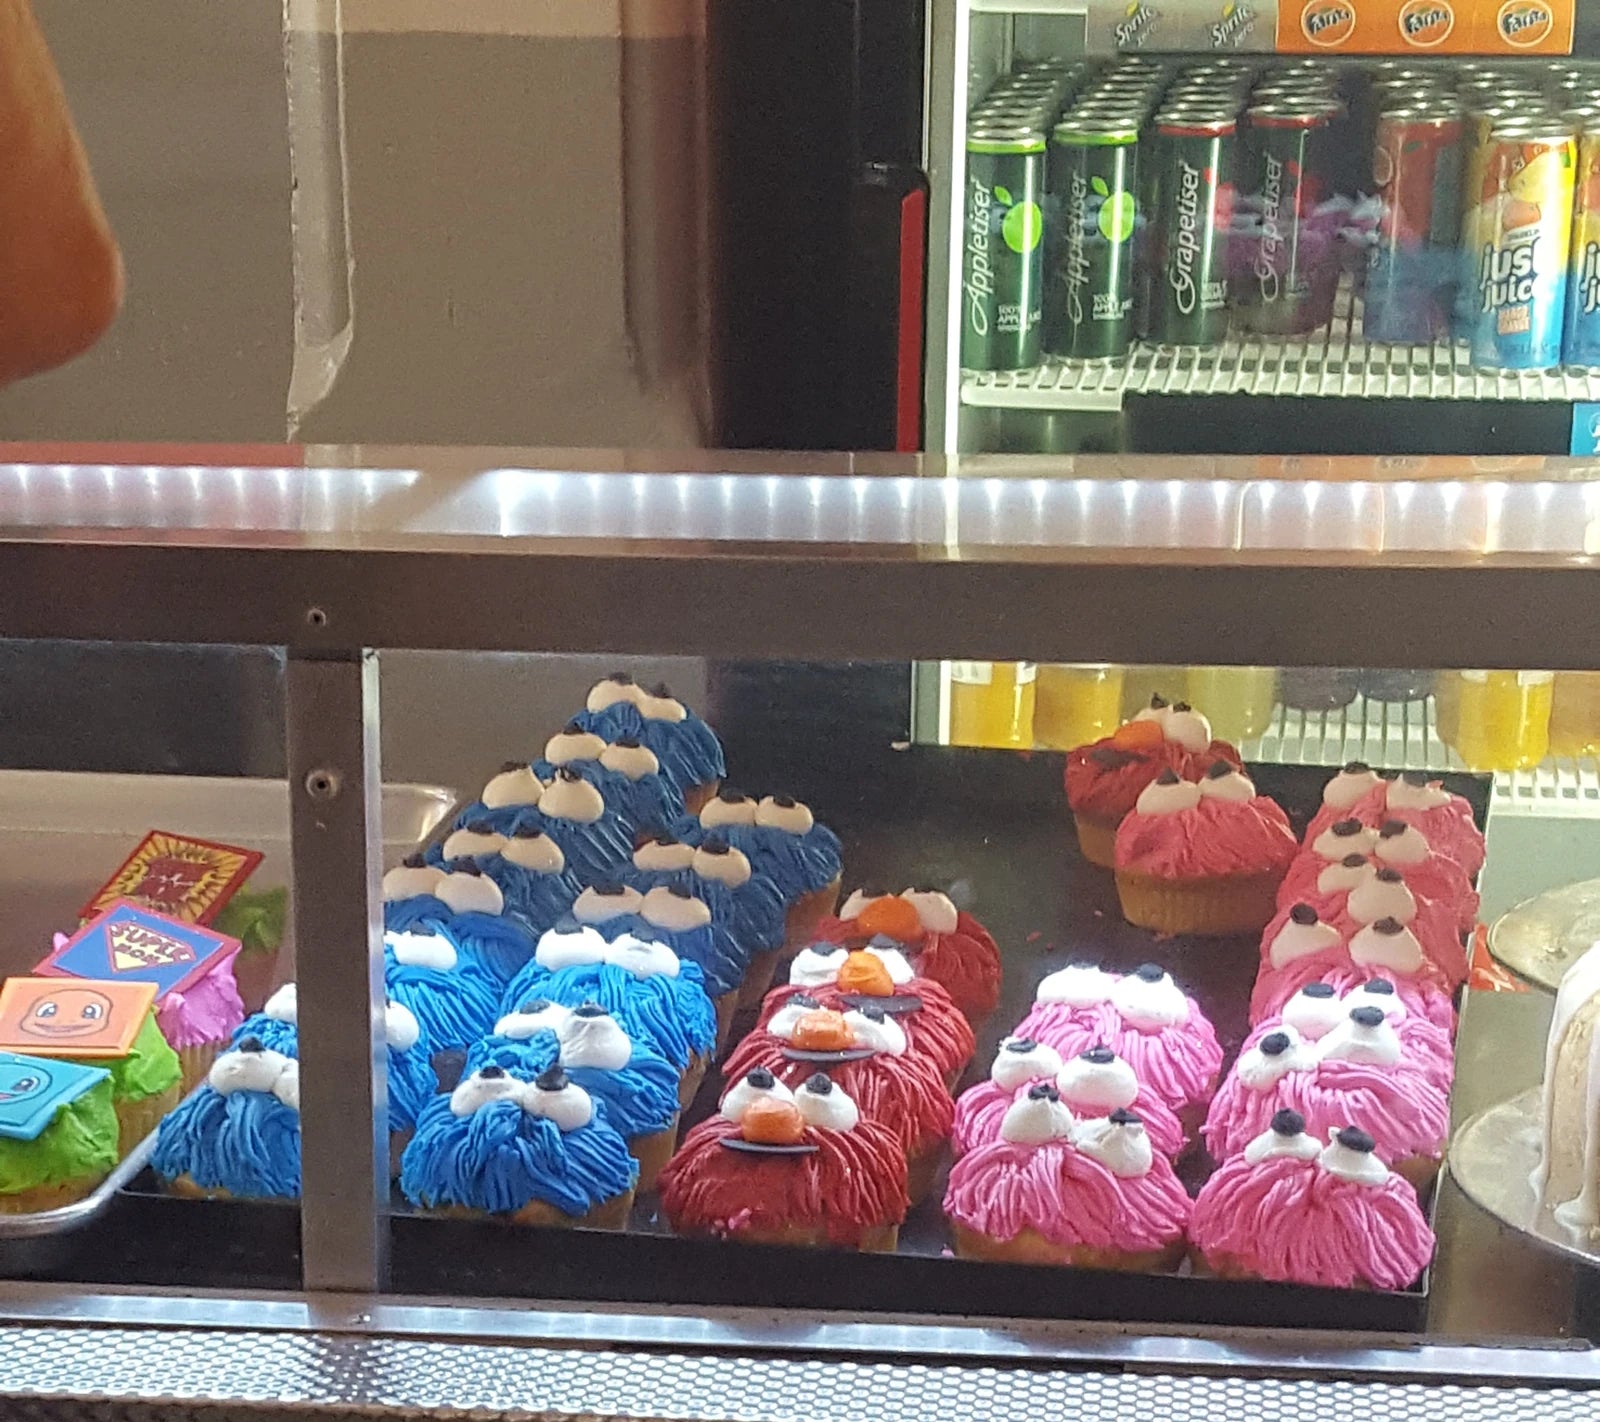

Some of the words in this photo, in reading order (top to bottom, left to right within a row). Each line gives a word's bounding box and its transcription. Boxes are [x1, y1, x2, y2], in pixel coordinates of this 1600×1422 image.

[965, 176, 994, 336] Appletiser
[1170, 160, 1199, 314] Grapetiser
[1254, 153, 1283, 301] Grapetiser
